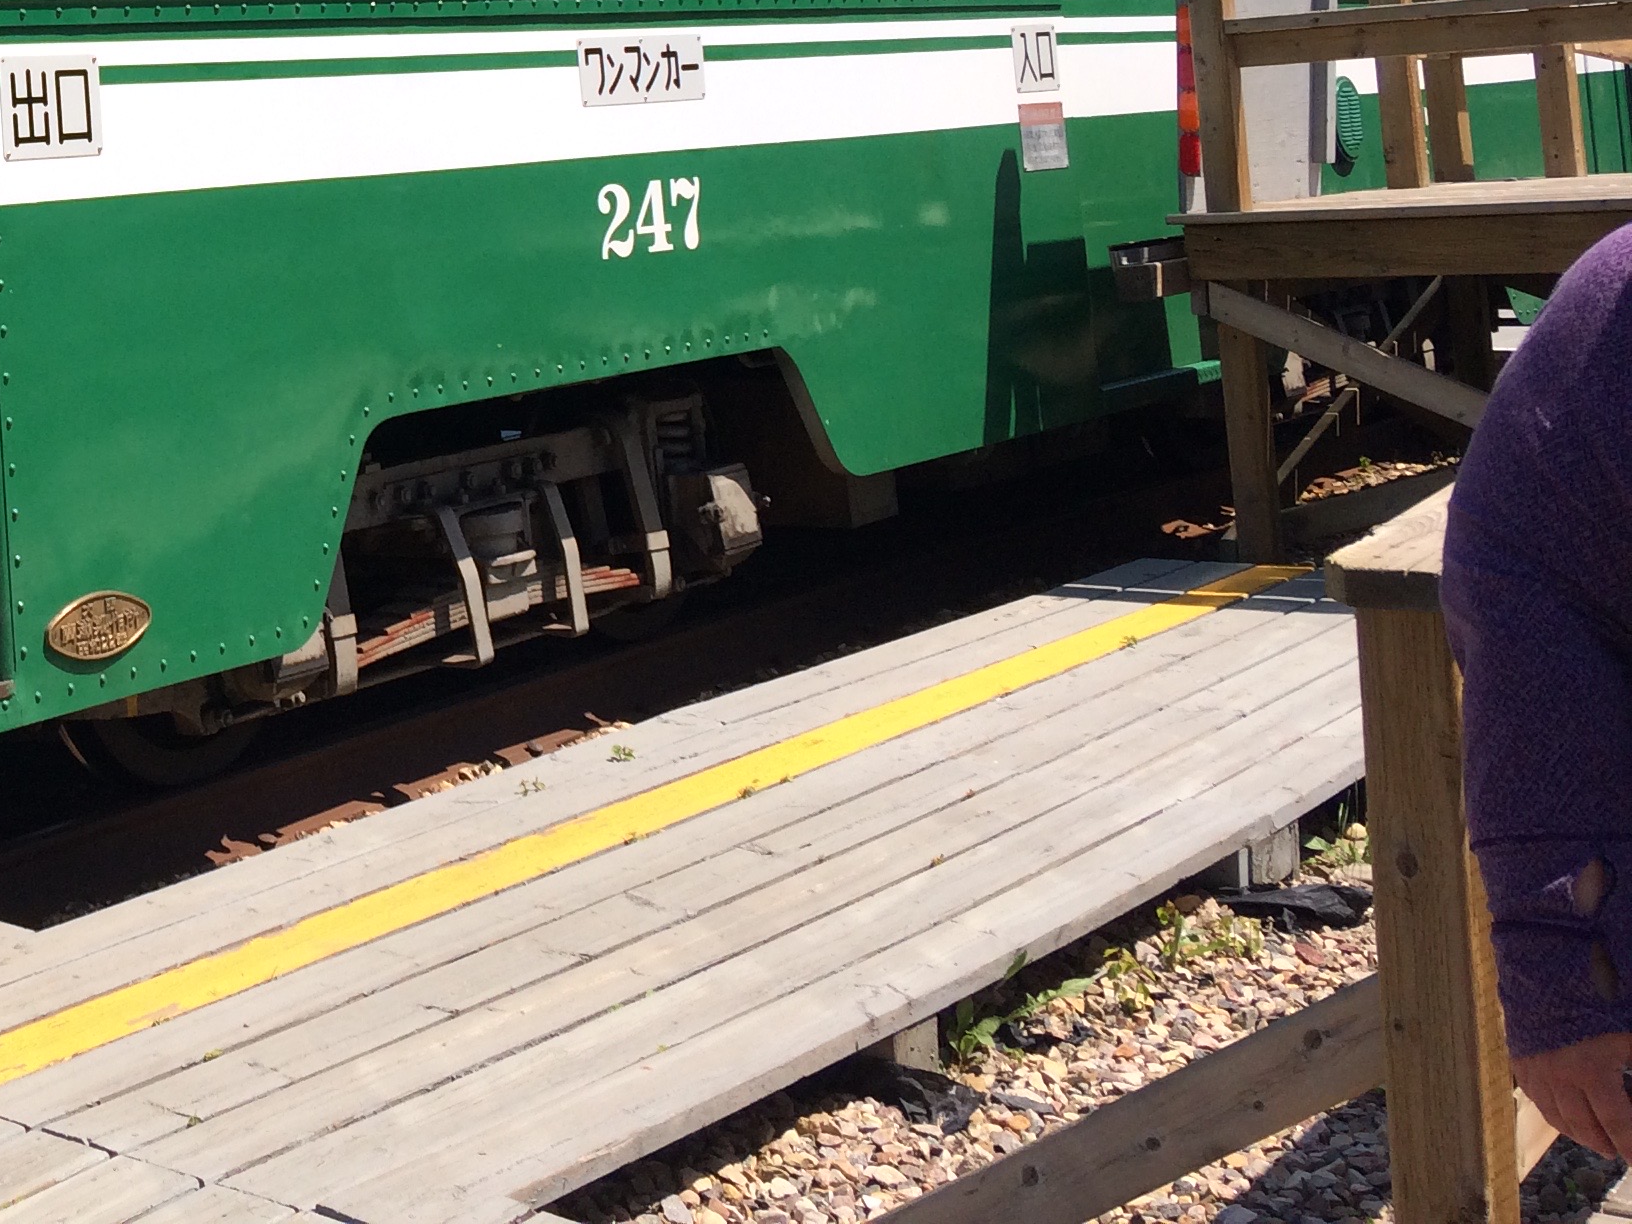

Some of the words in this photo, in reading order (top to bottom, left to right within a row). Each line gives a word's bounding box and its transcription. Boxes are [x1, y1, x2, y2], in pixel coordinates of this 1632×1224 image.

[584, 43, 700, 96] ワンマンカー
[1019, 31, 1055, 84] 入口
[9, 68, 93, 148] 出口
[597, 176, 700, 260] 247
